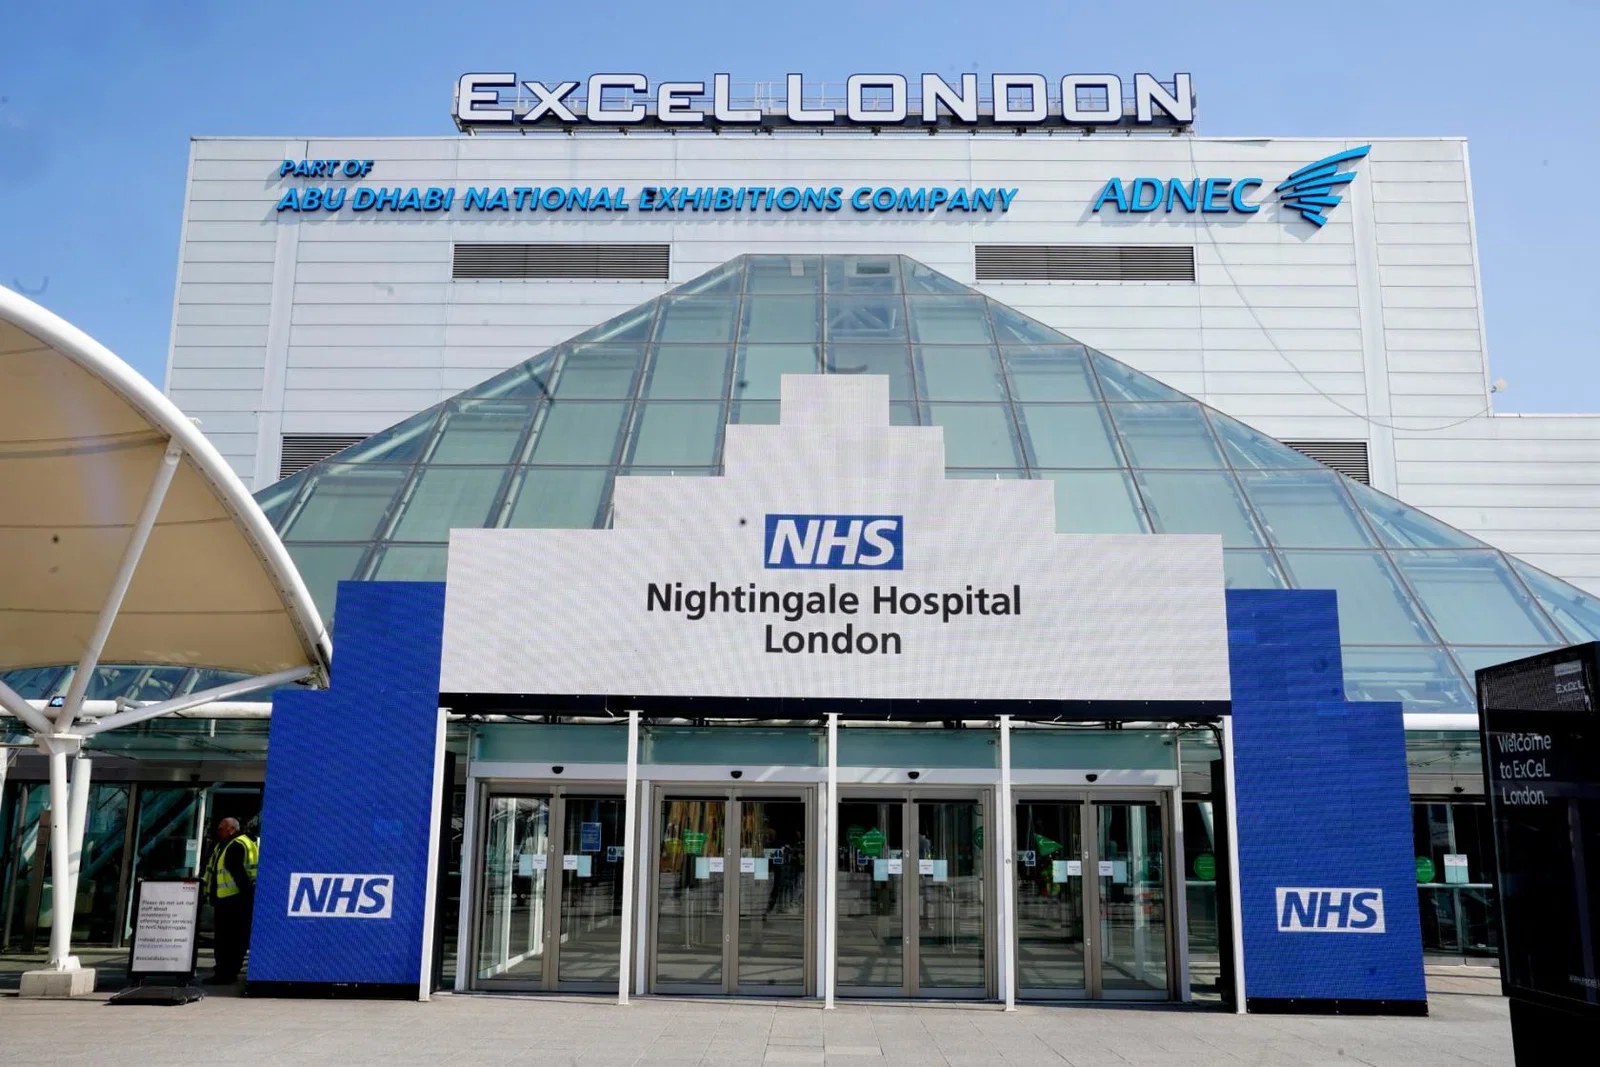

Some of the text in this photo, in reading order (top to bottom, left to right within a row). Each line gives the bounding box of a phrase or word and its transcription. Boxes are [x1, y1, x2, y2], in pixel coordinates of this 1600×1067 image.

[786, 73, 1194, 125] LONDON
[279, 159, 374, 177] PART OF
[277, 186, 1019, 212] ABU DHABI NATIONAL EXHIBITIONS COMPANY
[1092, 177, 1264, 213] ADNEC
[767, 518, 900, 566] NHS
[646, 581, 1021, 623] Nightingale Hospital
[764, 623, 902, 654] London
[1497, 734, 1552, 753] Welcome
[1500, 757, 1551, 779] to ExCeL
[1502, 785, 1548, 805] London.
[290, 876, 390, 914] NHS
[1280, 891, 1379, 929] NHS
